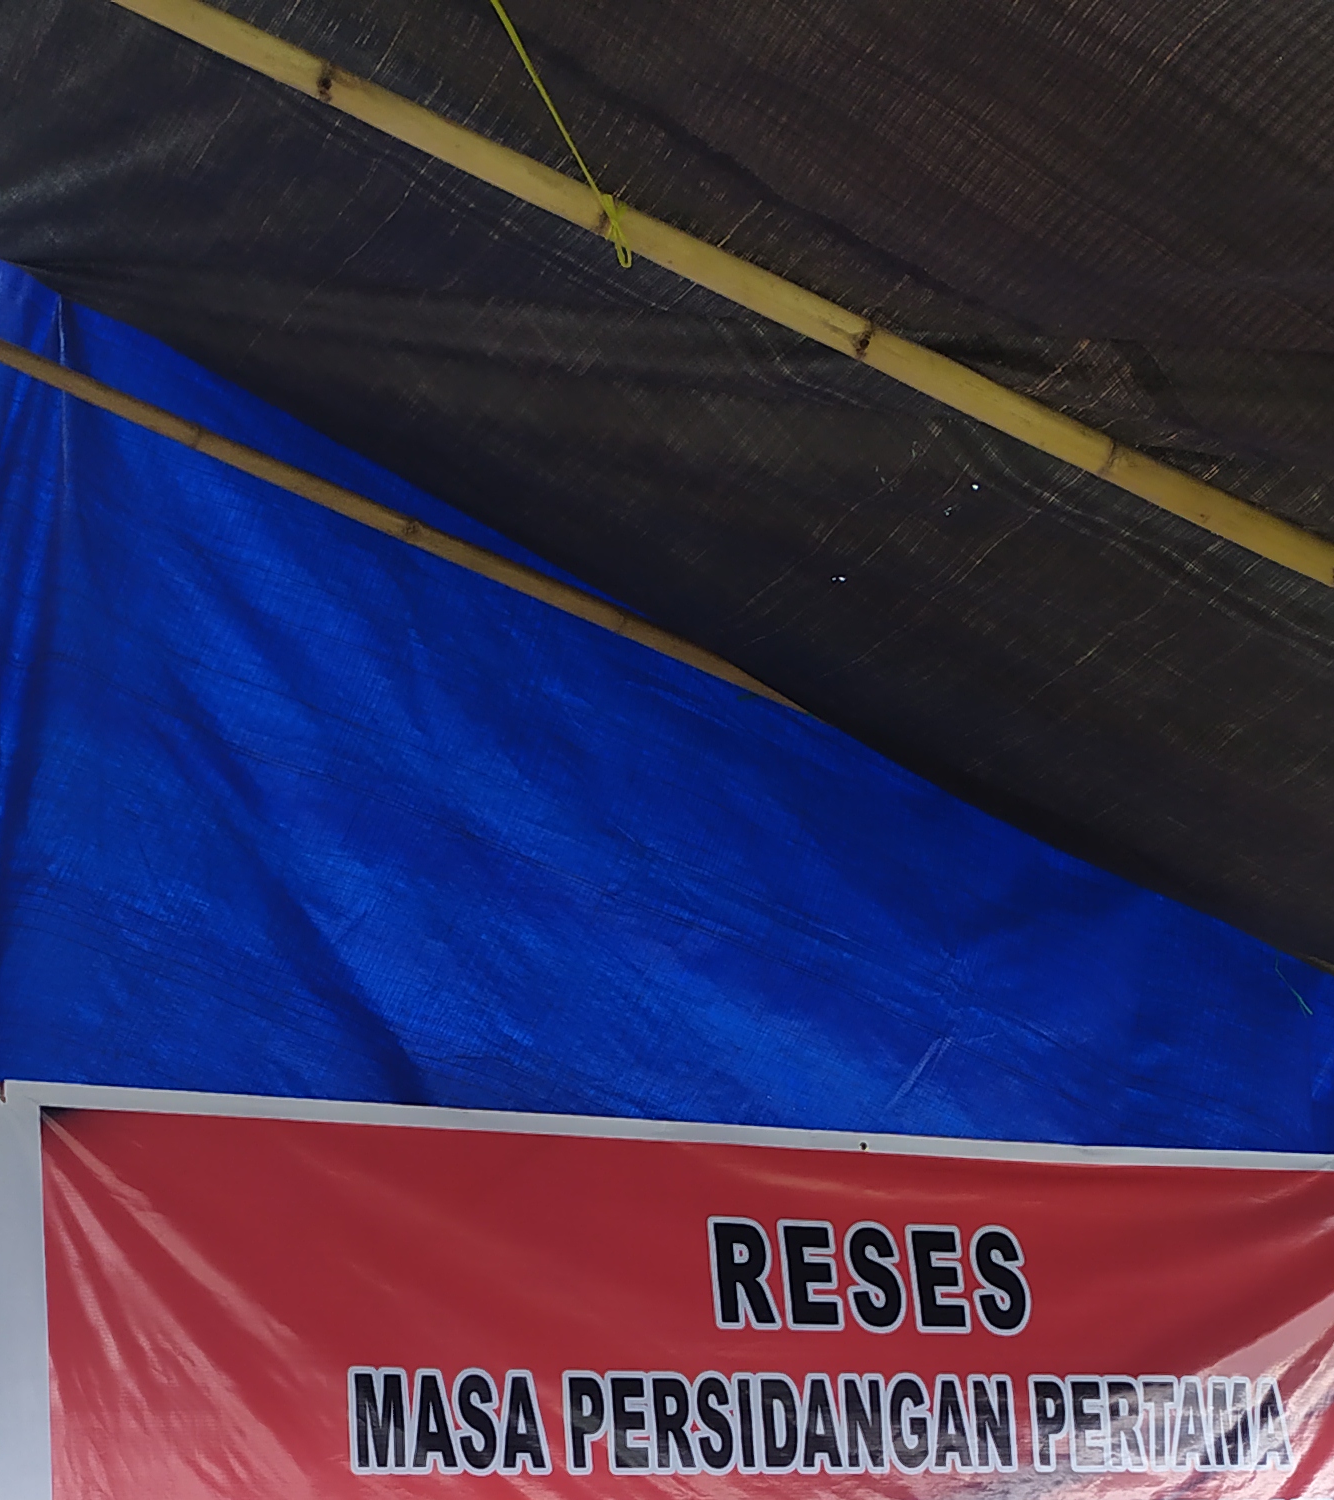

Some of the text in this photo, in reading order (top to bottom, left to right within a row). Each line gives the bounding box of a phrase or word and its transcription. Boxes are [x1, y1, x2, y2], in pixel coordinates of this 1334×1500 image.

[710, 1219, 1029, 1333] RESES
[350, 1369, 1290, 1474] MASA PERSIDANGAN PERTAMA
